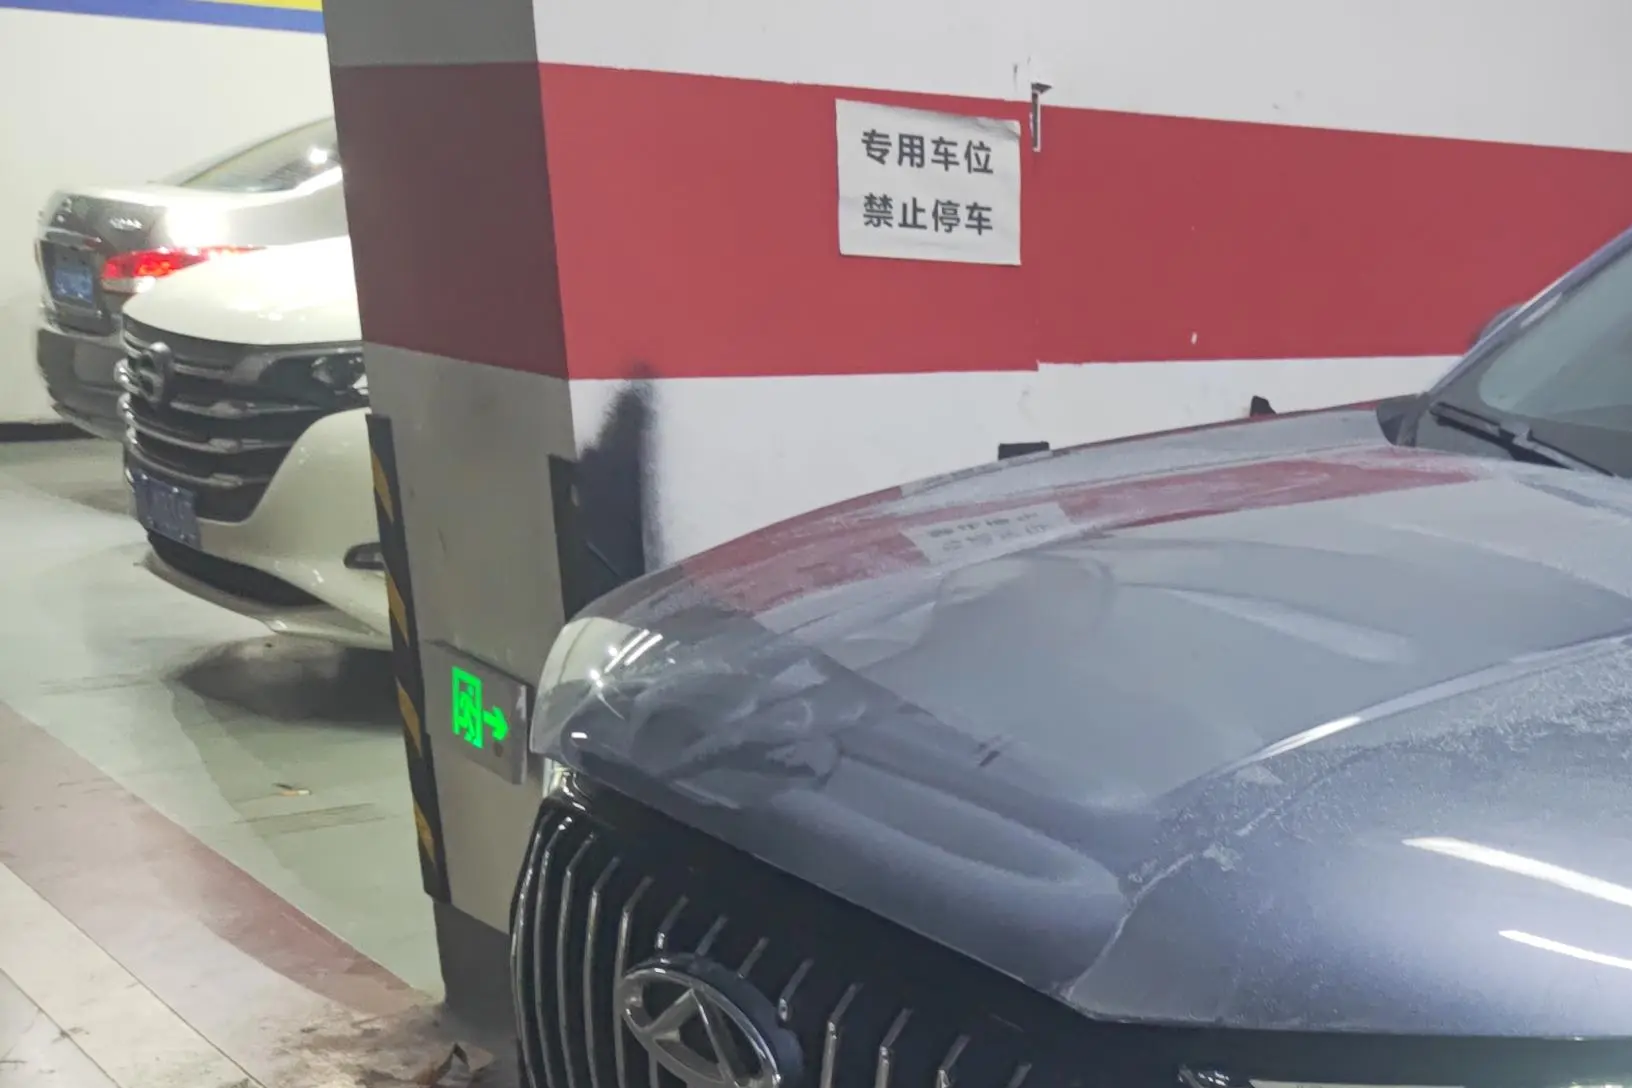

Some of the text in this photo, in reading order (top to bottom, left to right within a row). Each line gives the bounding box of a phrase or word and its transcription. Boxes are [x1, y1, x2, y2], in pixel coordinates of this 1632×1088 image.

[861, 129, 994, 174] 专用车位
[863, 193, 993, 236] 禁止停车
